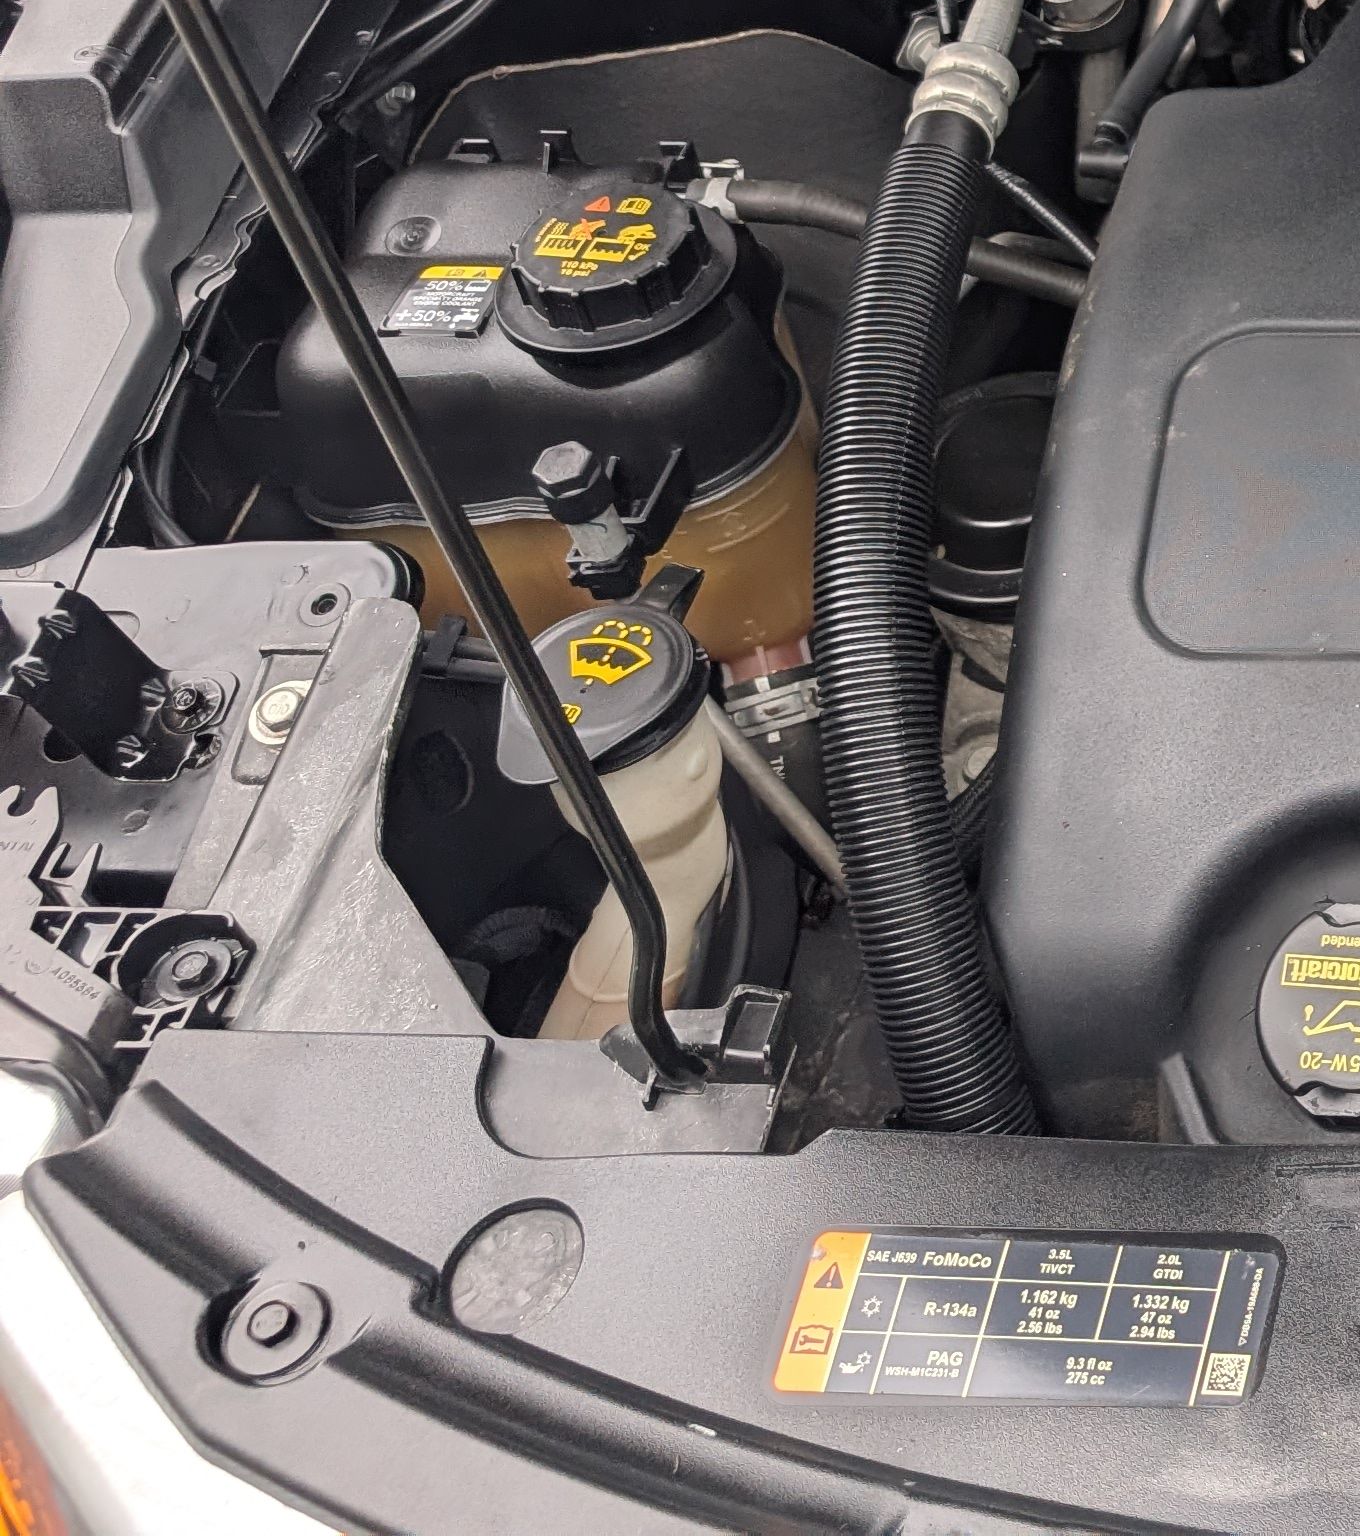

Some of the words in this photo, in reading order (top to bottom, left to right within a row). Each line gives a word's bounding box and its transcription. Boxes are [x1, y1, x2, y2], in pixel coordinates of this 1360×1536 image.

[424, 281, 463, 290] 50%
[1300, 1051, 1360, 1073] 5W-20
[867, 1250, 891, 1262] SAE
[892, 1252, 917, 1263] J639
[922, 1252, 992, 1269] FoMoCo
[1048, 1249, 1073, 1260] 3.5L
[1157, 1254, 1182, 1265] 2.0L
[1020, 1289, 1058, 1304] 1.162
[1059, 1291, 1078, 1308] kg
[1132, 1293, 1170, 1309] 1.332
[1171, 1296, 1189, 1313] kg
[923, 1302, 978, 1317] R-134a
[1028, 1306, 1043, 1318] 41
[1045, 1309, 1060, 1319] oz
[1140, 1311, 1153, 1324] 47
[1157, 1314, 1172, 1324] oz
[1017, 1321, 1042, 1333] 2.56
[1044, 1323, 1062, 1334] lbs
[1129, 1326, 1154, 1338] 2.94
[1156, 1328, 1175, 1339] lbs
[927, 1350, 964, 1365] PAG
[1066, 1357, 1085, 1370] 9.3
[1086, 1358, 1096, 1370] fl
[1097, 1361, 1113, 1371] oz
[1065, 1372, 1088, 1384] 275
[1090, 1374, 1105, 1385] cc
